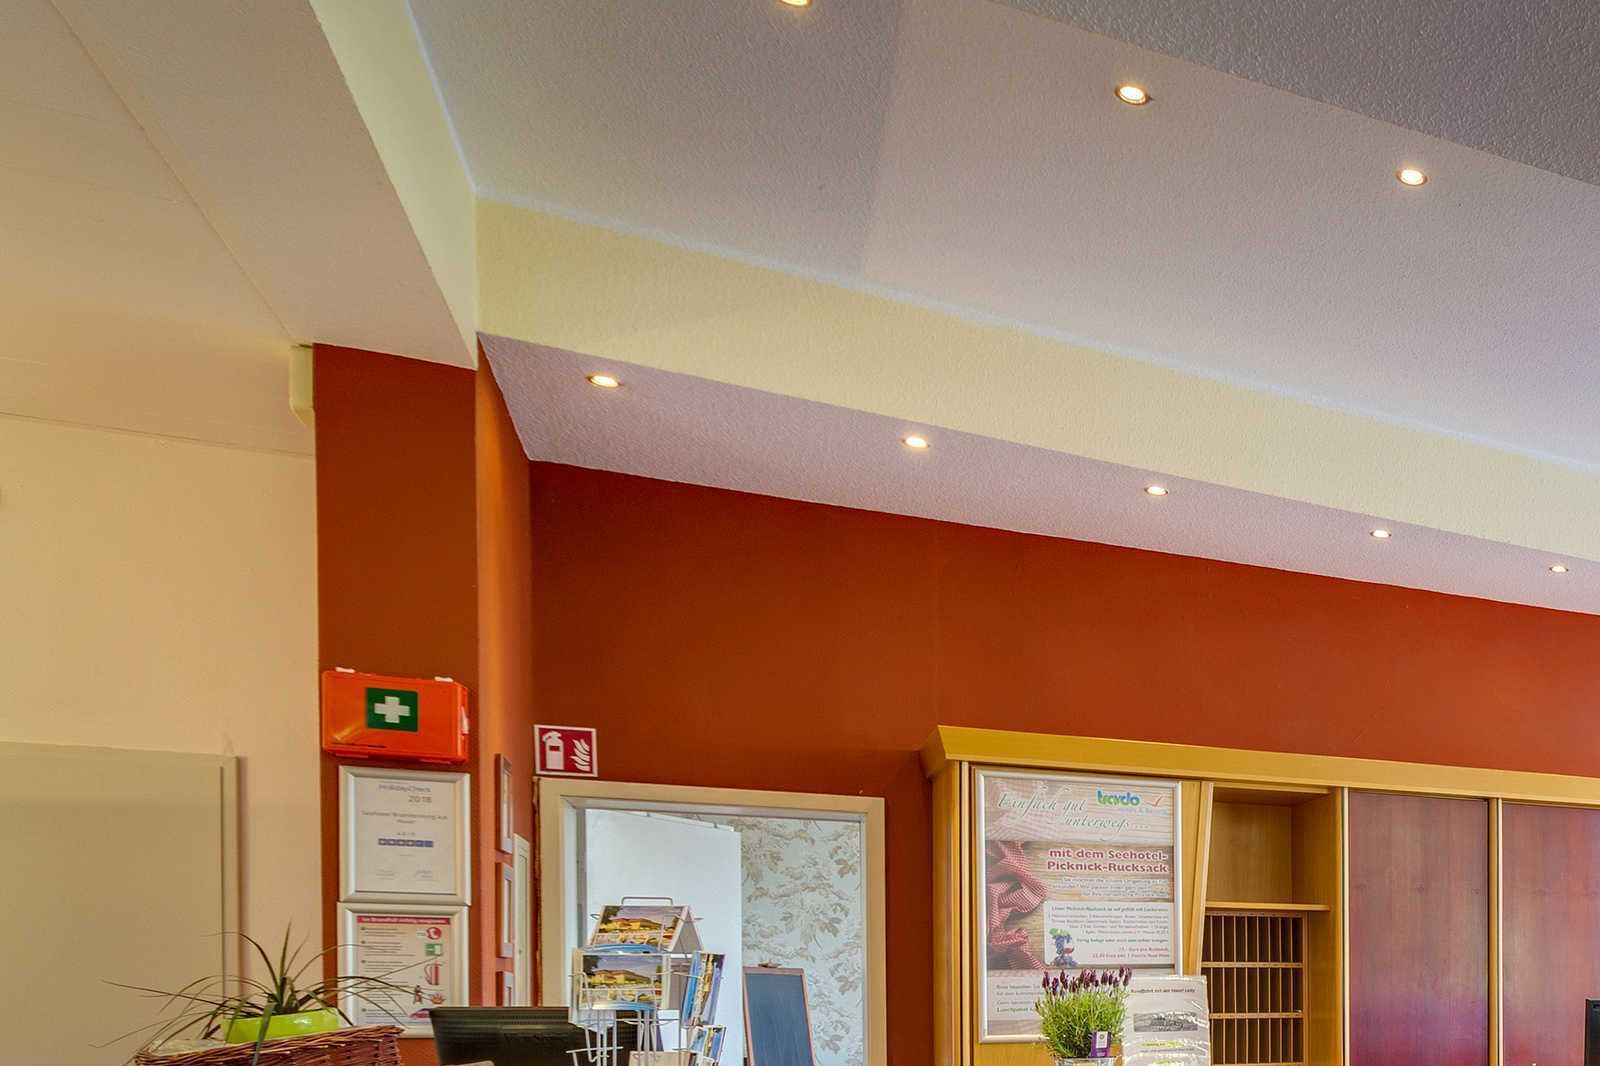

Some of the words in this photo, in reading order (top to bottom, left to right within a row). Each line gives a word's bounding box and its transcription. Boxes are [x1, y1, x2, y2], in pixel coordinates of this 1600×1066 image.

[998, 787, 1057, 817] Einfach
[1063, 797, 1088, 812] gut
[1064, 815, 1130, 833] unterwegs
[1049, 849, 1072, 858] mit
[1076, 849, 1104, 859] dem
[1108, 850, 1168, 860] Seehotel-
[1047, 861, 1168, 873] Picknick-Rucksack
